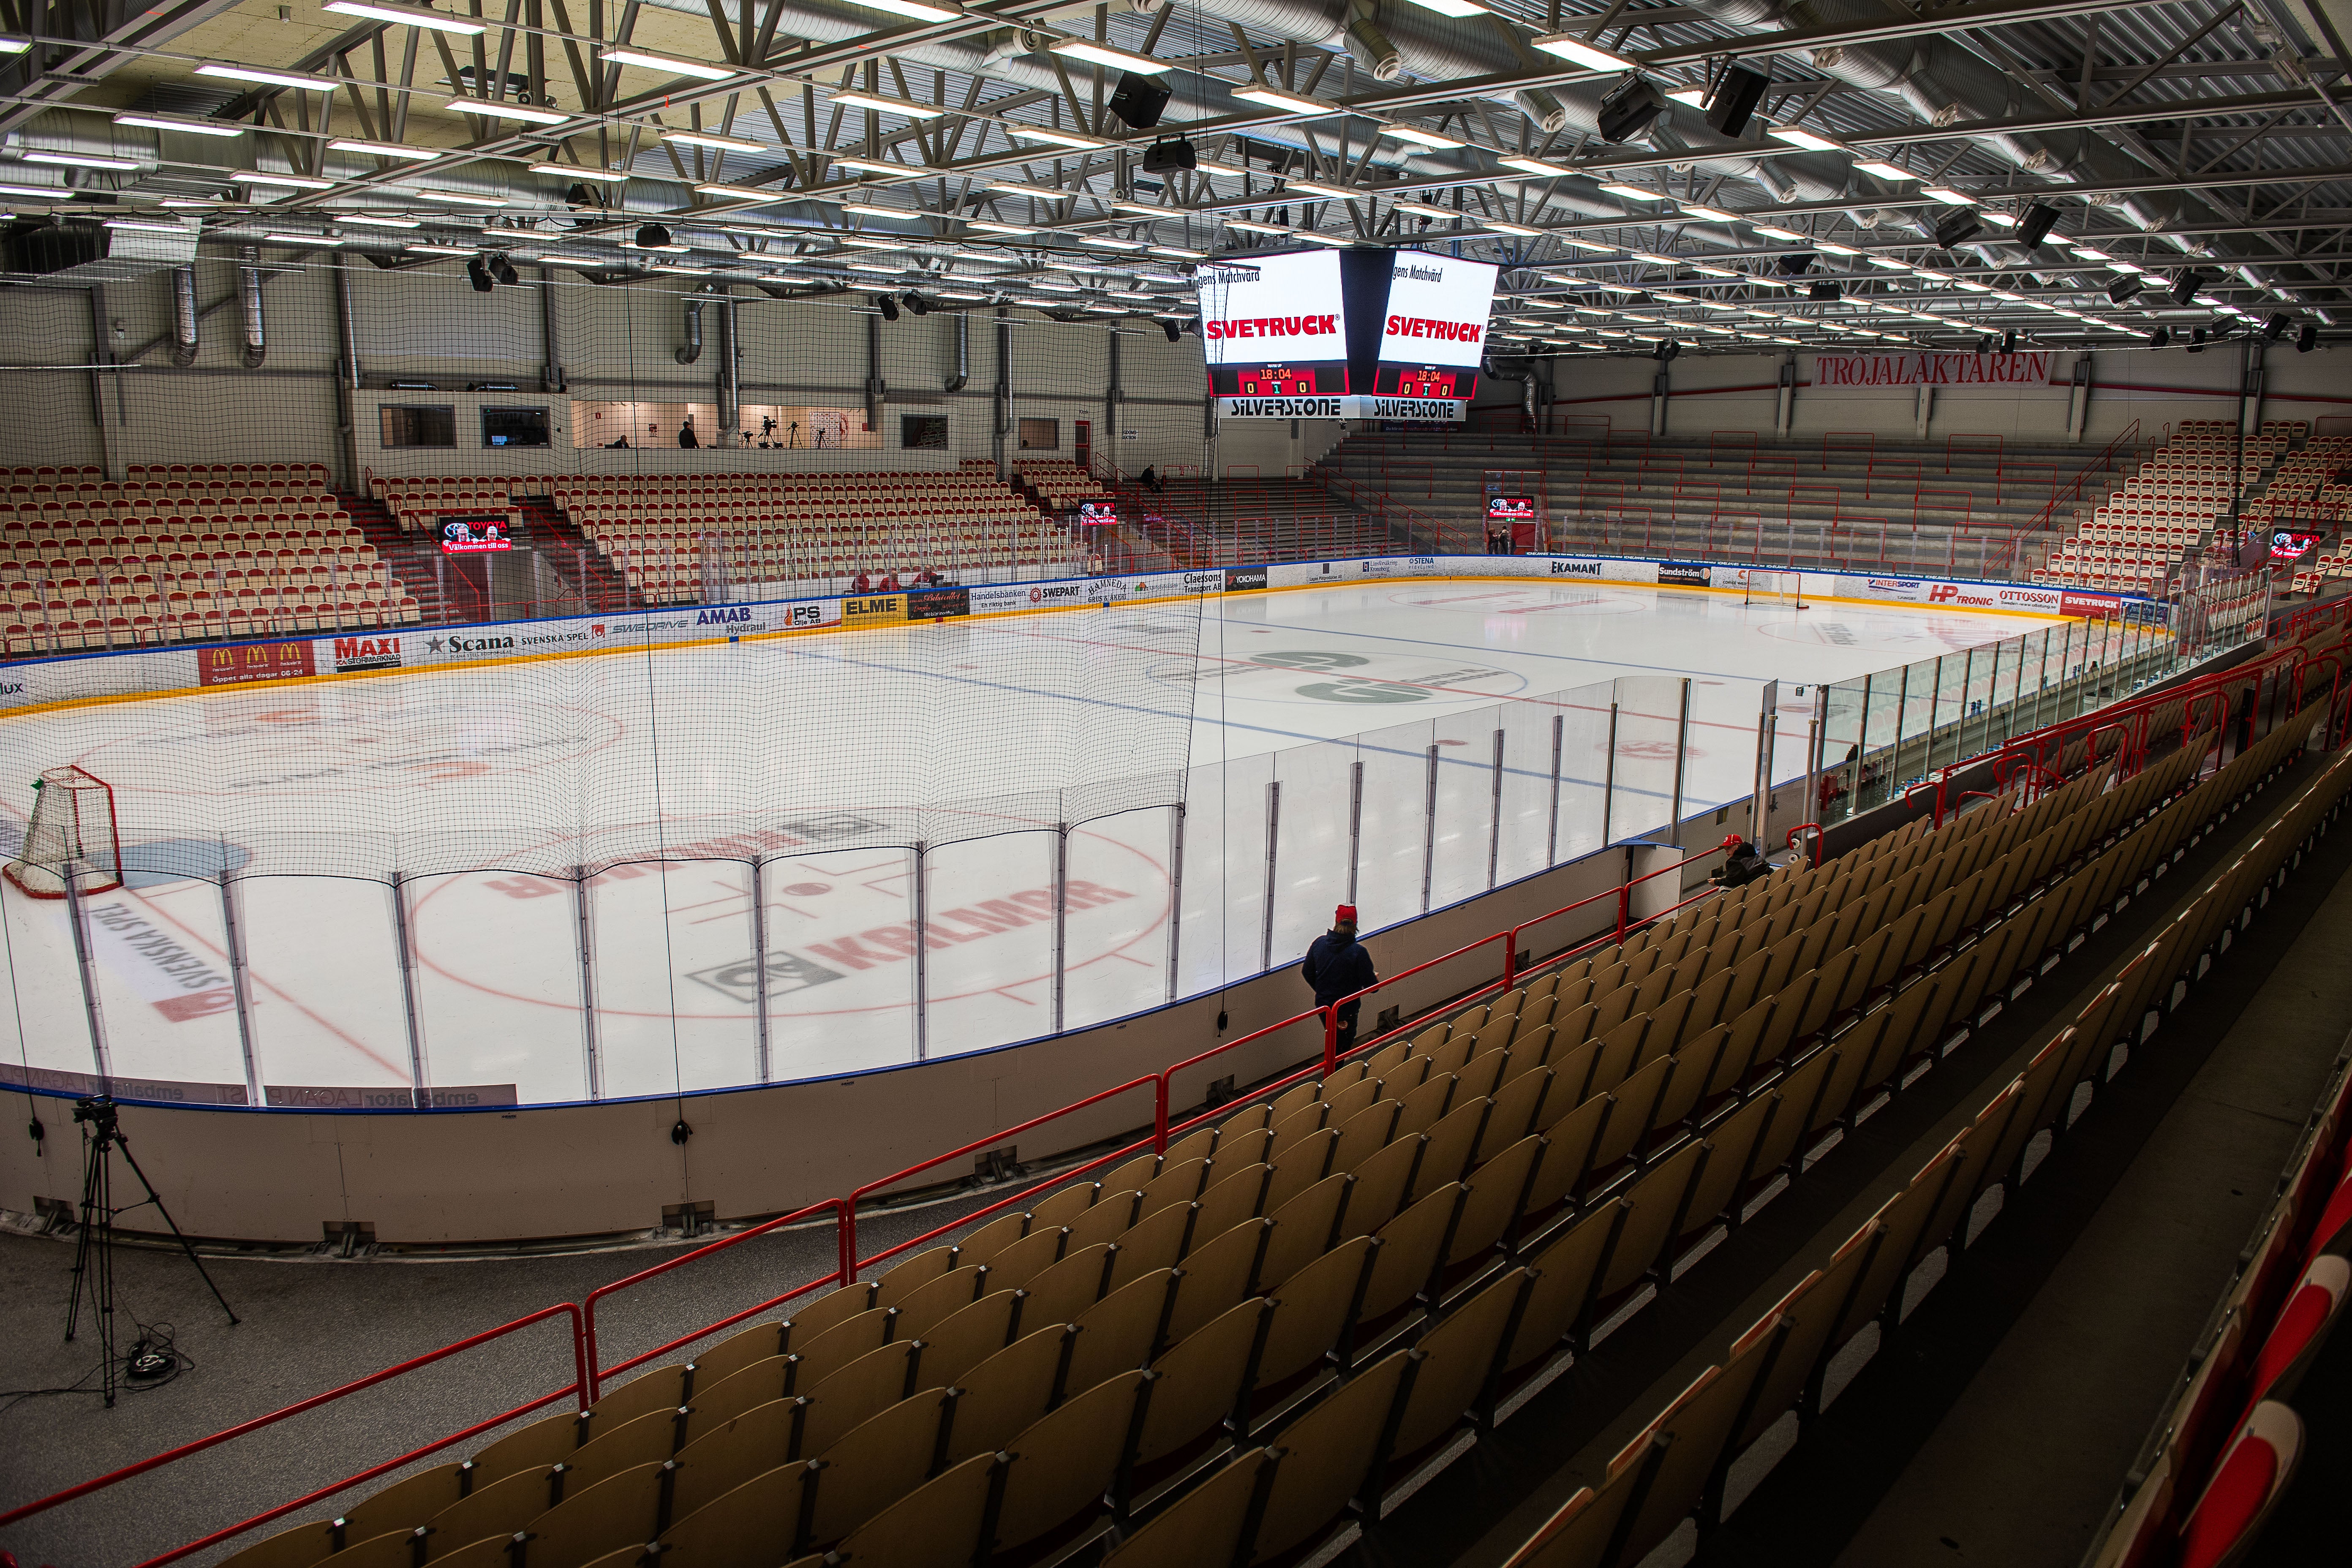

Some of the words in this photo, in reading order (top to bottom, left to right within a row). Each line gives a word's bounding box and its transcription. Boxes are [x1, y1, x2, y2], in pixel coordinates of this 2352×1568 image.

[1199, 275, 1216, 289] gens
[1218, 269, 1260, 284] Matchvärd
[1393, 266, 1408, 280] gens
[1409, 264, 1443, 283] Matchvärd
[1261, 369, 1291, 380] 18:04
[1817, 351, 2050, 385] TROJALÄKTAREN
[1418, 370, 1440, 381] 18:04
[1247, 383, 1254, 393] 0
[1274, 385, 1280, 393] 1
[1299, 382, 1306, 393] 0
[1404, 384, 1410, 394] 0
[1424, 387, 1428, 396] 1
[1442, 385, 1448, 396] 0
[1231, 398, 1341, 416] SILVERSTONE
[1374, 399, 1454, 419] SILVERSTONE
[467, 521, 507, 530] TOYOTA
[449, 542, 487, 551] Välkommen
[1551, 561, 1602, 576] EKAMANT
[1659, 567, 1700, 577] Sundström
[1184, 573, 1221, 584] Claessons
[1236, 574, 1266, 584] YOKOHAMA
[1876, 579, 1920, 588] INTERSPORT
[1043, 586, 1080, 598] SWEPART
[1088, 579, 1127, 596] HAMNEDA
[1184, 585, 1211, 593] Transport
[1213, 583, 1221, 591] AB
[971, 590, 1026, 601] Handelsbanken
[1929, 584, 1959, 602] HP
[1957, 595, 1993, 606] TRONIC
[1999, 590, 2060, 604] OTTOSSON
[2065, 596, 2117, 609] SVETRUCK
[696, 607, 751, 626] AMAB
[794, 606, 820, 621] PS
[613, 620, 688, 634] SWEDRIVE
[726, 622, 766, 635] Hydraul
[449, 636, 515, 653] Scana
[521, 634, 564, 645] SVENSKA
[566, 632, 588, 641] SPEL
[334, 637, 400, 659] MAXI
[348, 654, 401, 665] STORMARKNAD
[212, 675, 237, 683] Öppet
[0, 682, 24, 695] lux
[88, 903, 150, 932] SPEL
[807, 880, 1134, 970] KALMAR
[123, 930, 228, 989] SVENSKA
